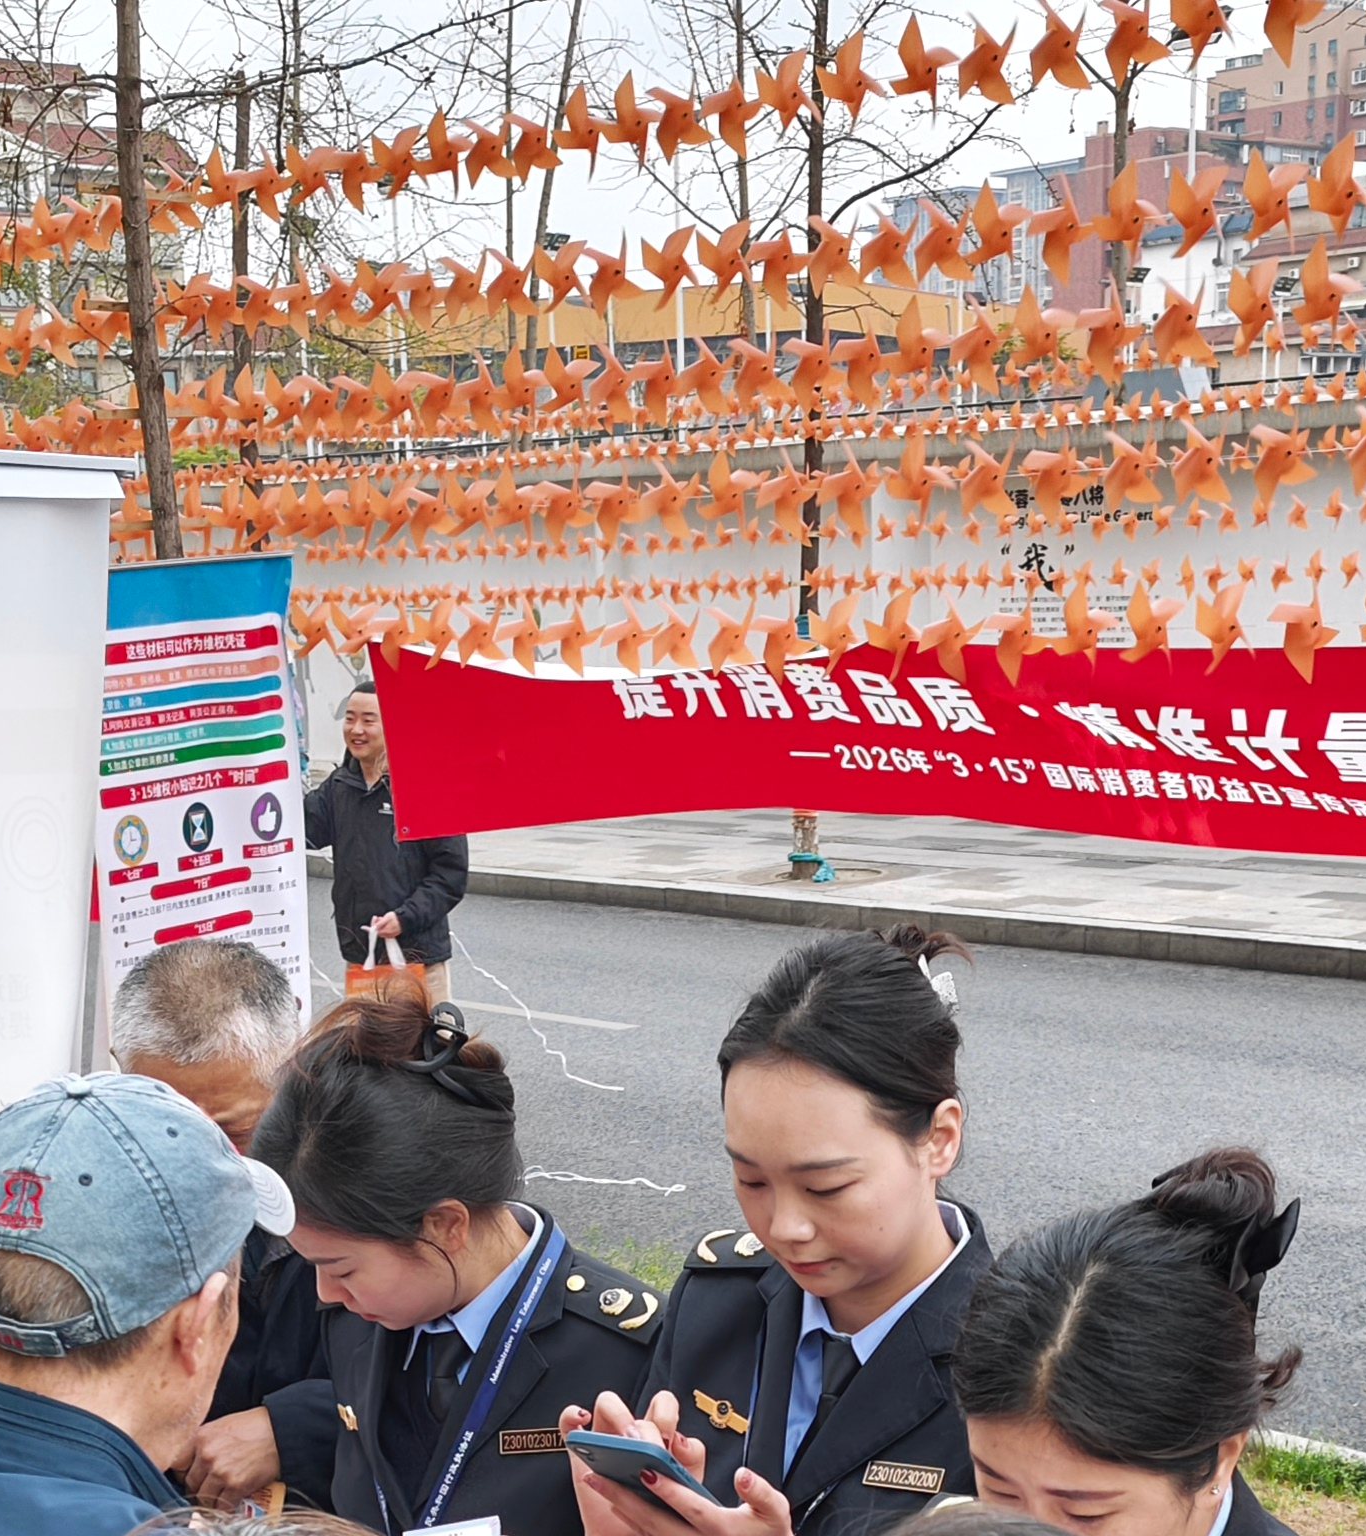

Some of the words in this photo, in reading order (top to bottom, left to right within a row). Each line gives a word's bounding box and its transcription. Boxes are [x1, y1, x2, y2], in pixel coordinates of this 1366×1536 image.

[125, 633, 247, 661] 这些材料可以作为维权凭证
[867, 1465, 938, 1489] 23010230200
